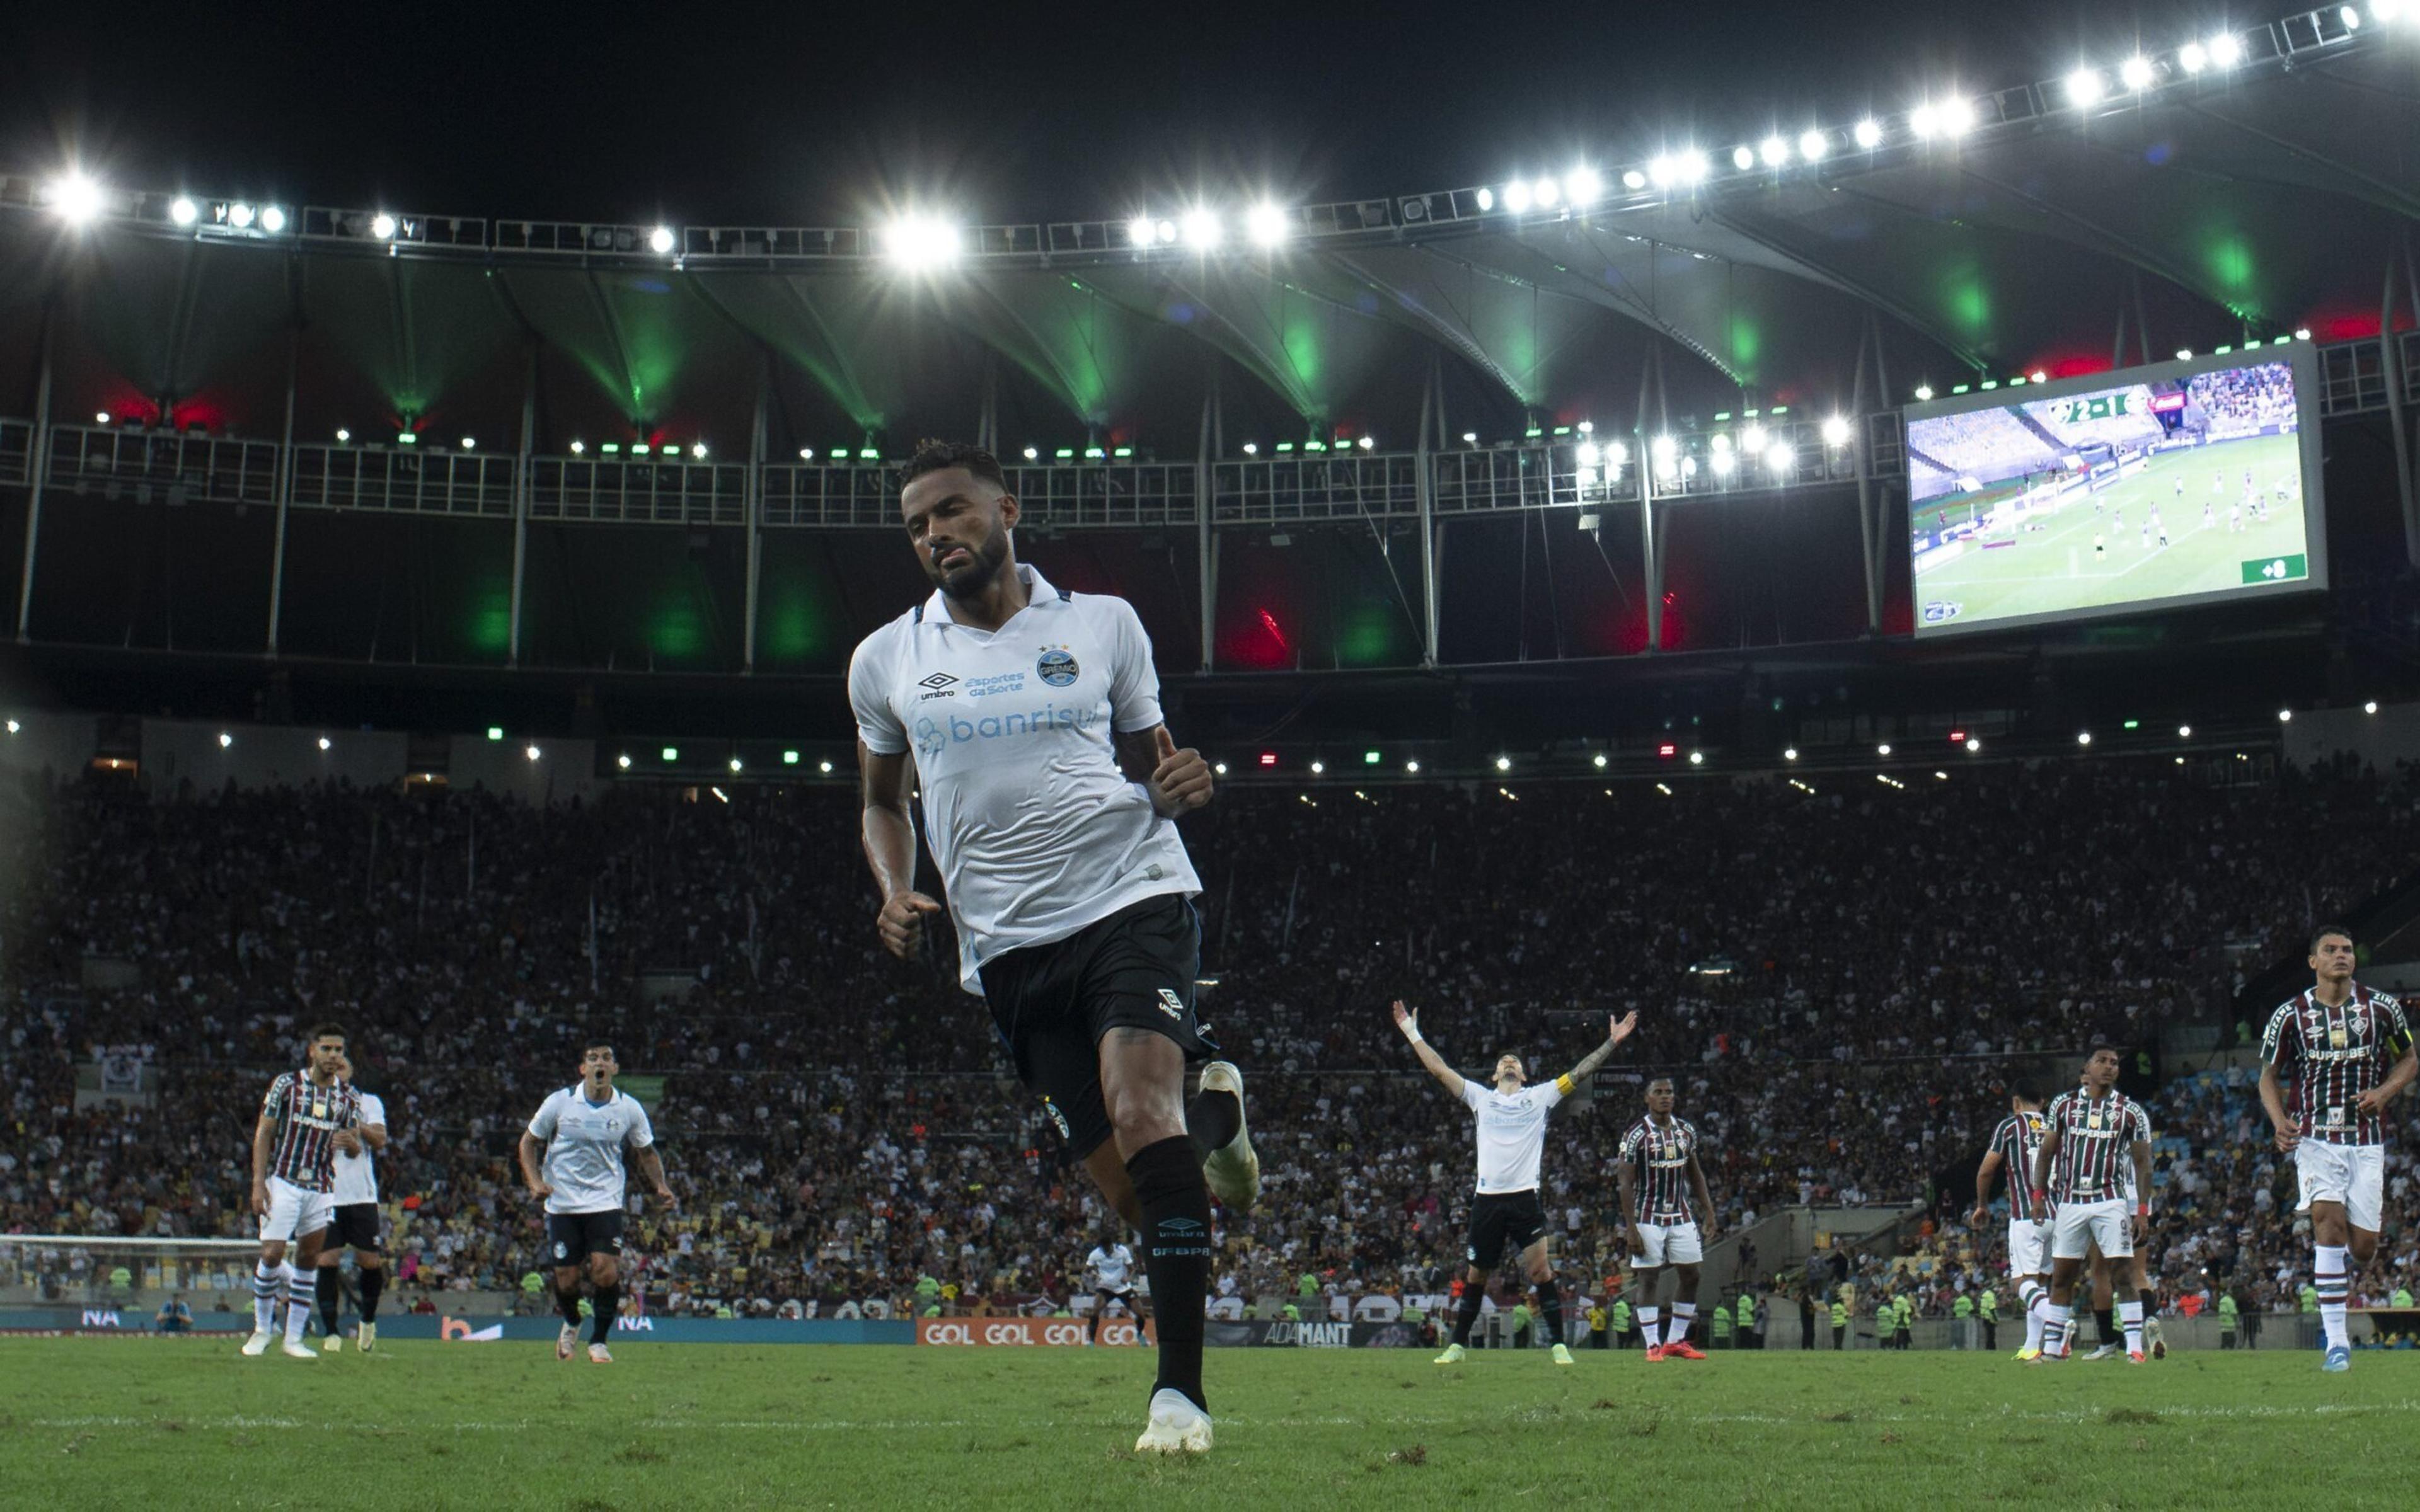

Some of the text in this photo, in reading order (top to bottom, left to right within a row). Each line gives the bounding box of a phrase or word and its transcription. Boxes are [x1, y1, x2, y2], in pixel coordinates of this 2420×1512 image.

[965, 672, 1025, 687] Esportes
[921, 690, 955, 700] umbro
[987, 682, 1023, 695] Sorte
[2267, 1004, 2292, 1047] ZINZANE
[2069, 1125, 2119, 1138] SUPERBET
[81, 1310, 120, 1326] NA
[618, 1316, 653, 1331] NA
[925, 1324, 976, 1346] GOL
[985, 1324, 1035, 1346] GOL
[1263, 1322, 1352, 1344] ADAMANT
